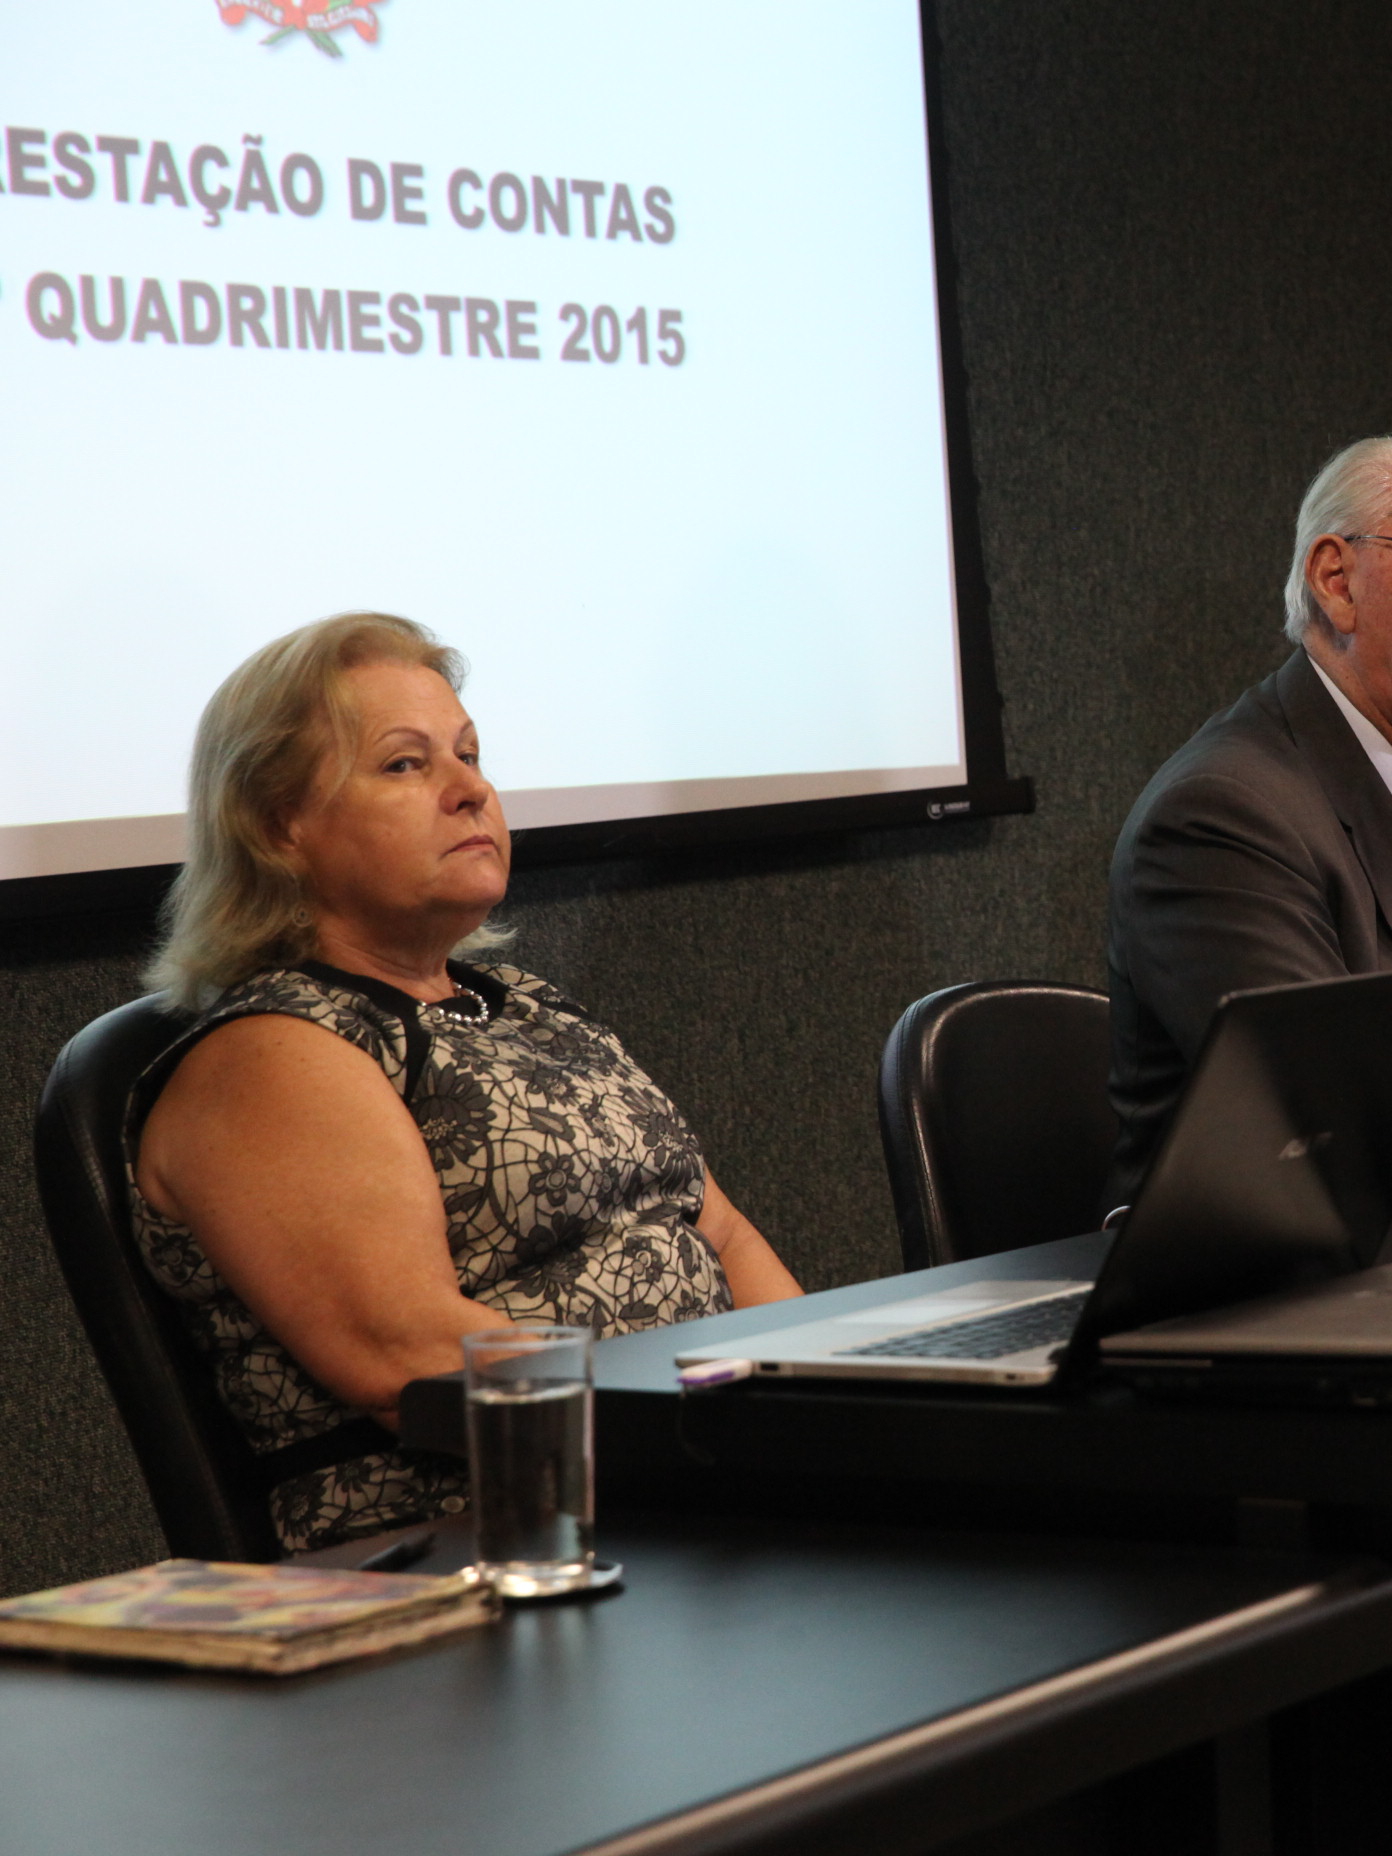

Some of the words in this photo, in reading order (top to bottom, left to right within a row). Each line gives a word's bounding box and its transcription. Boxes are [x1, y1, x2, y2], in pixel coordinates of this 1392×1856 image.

[0, 126, 325, 229] ESTAÇÃO
[347, 158, 428, 226] DE
[447, 167, 676, 245] CONTAS
[25, 271, 541, 361] QUADRIMESTRE
[559, 302, 686, 367] 2015
